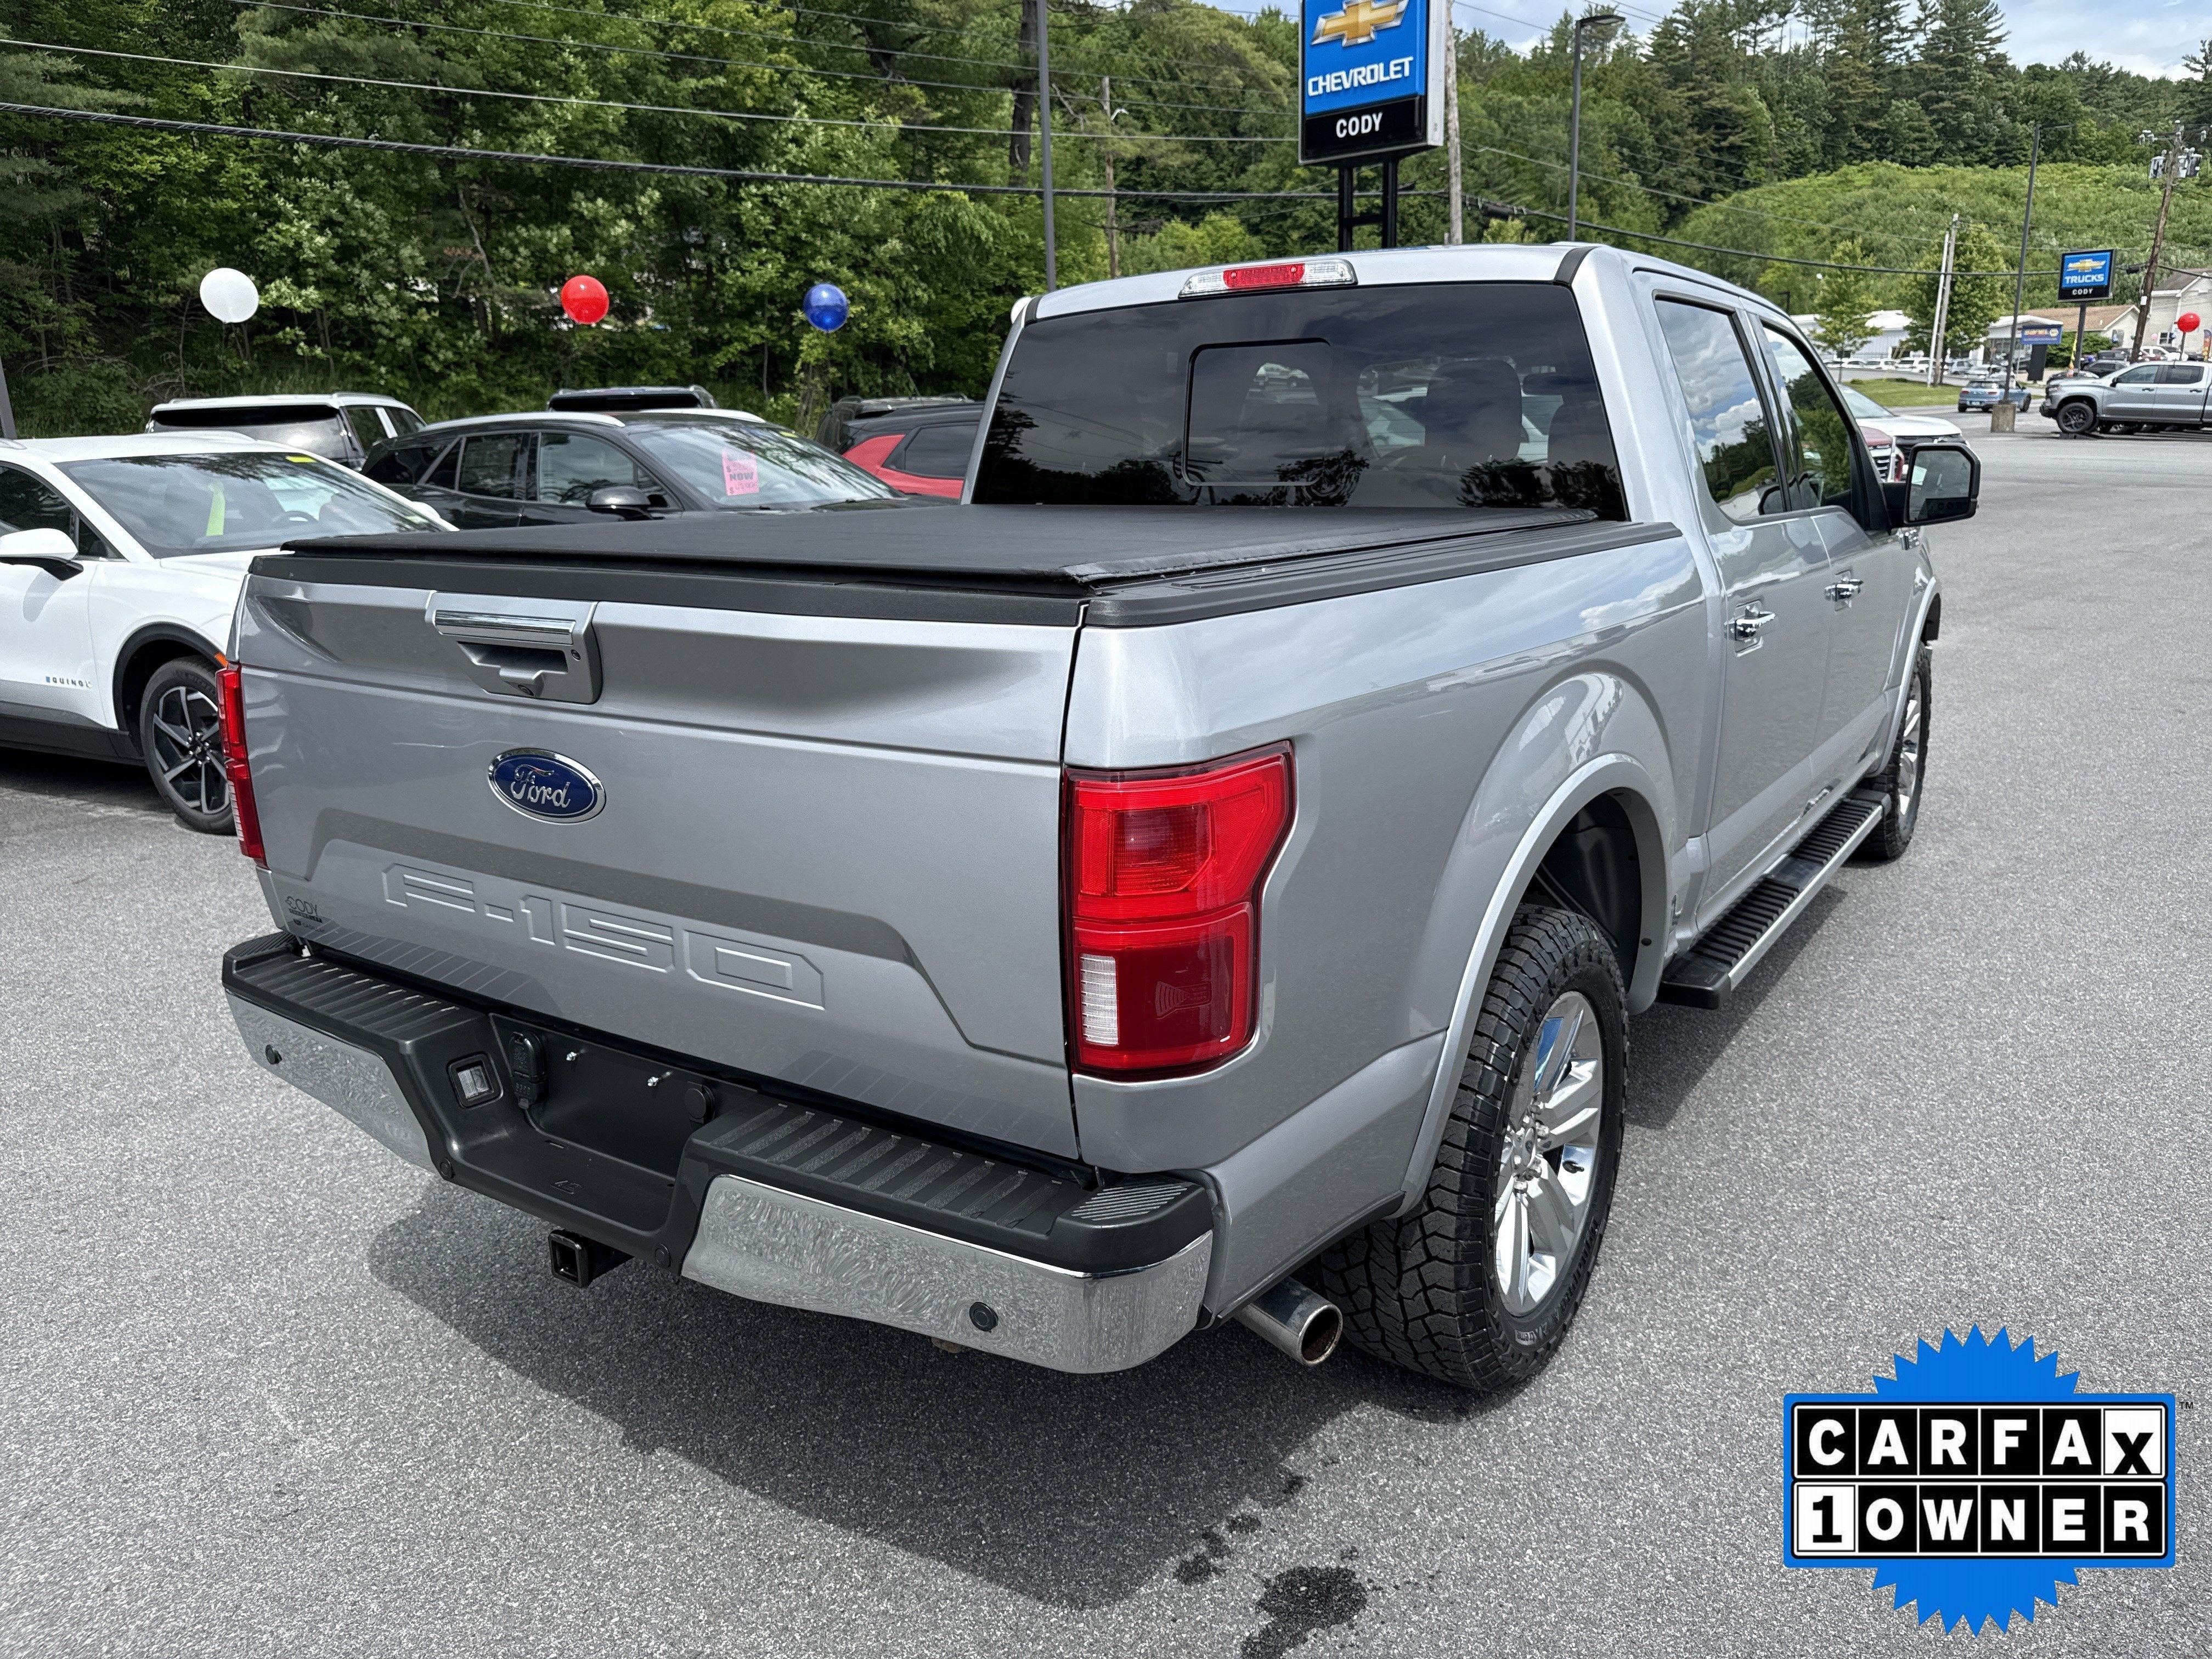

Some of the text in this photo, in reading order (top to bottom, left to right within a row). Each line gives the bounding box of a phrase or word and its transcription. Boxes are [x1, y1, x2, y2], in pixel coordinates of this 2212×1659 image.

[1308, 56, 1414, 97] CHEVROLET
[1336, 112, 1383, 138] CODY
[2065, 274, 2104, 284] TRUCKS
[730, 472, 753, 481] NOW
[510, 764, 571, 808] Ford
[285, 896, 318, 917] CODY
[382, 862, 826, 1011] F-150
